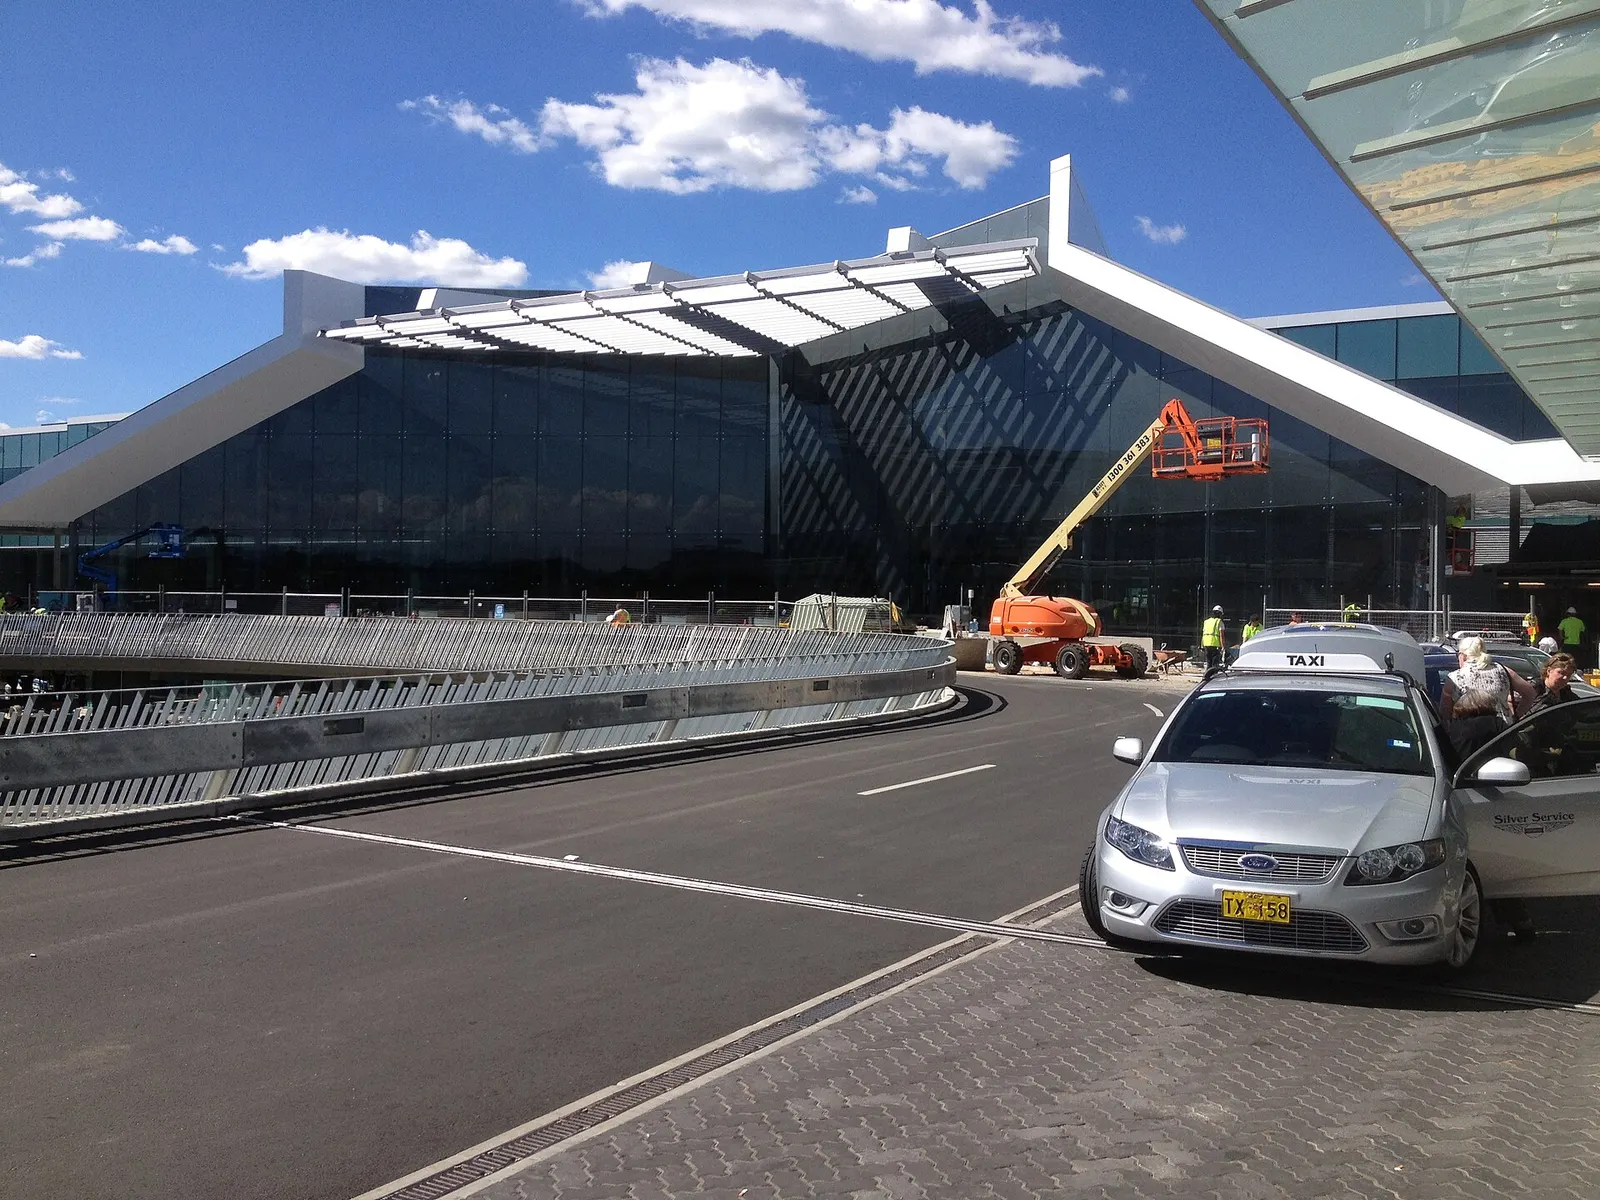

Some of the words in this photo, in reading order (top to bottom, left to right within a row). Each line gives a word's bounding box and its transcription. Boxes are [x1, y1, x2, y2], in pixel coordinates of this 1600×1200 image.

[1107, 463, 1124, 482] 1300
[1122, 450, 1136, 465] 361
[1135, 435, 1150, 452] 383
[1286, 655, 1325, 667] TAXI
[1494, 814, 1529, 825] Silver
[1531, 812, 1576, 822] Service
